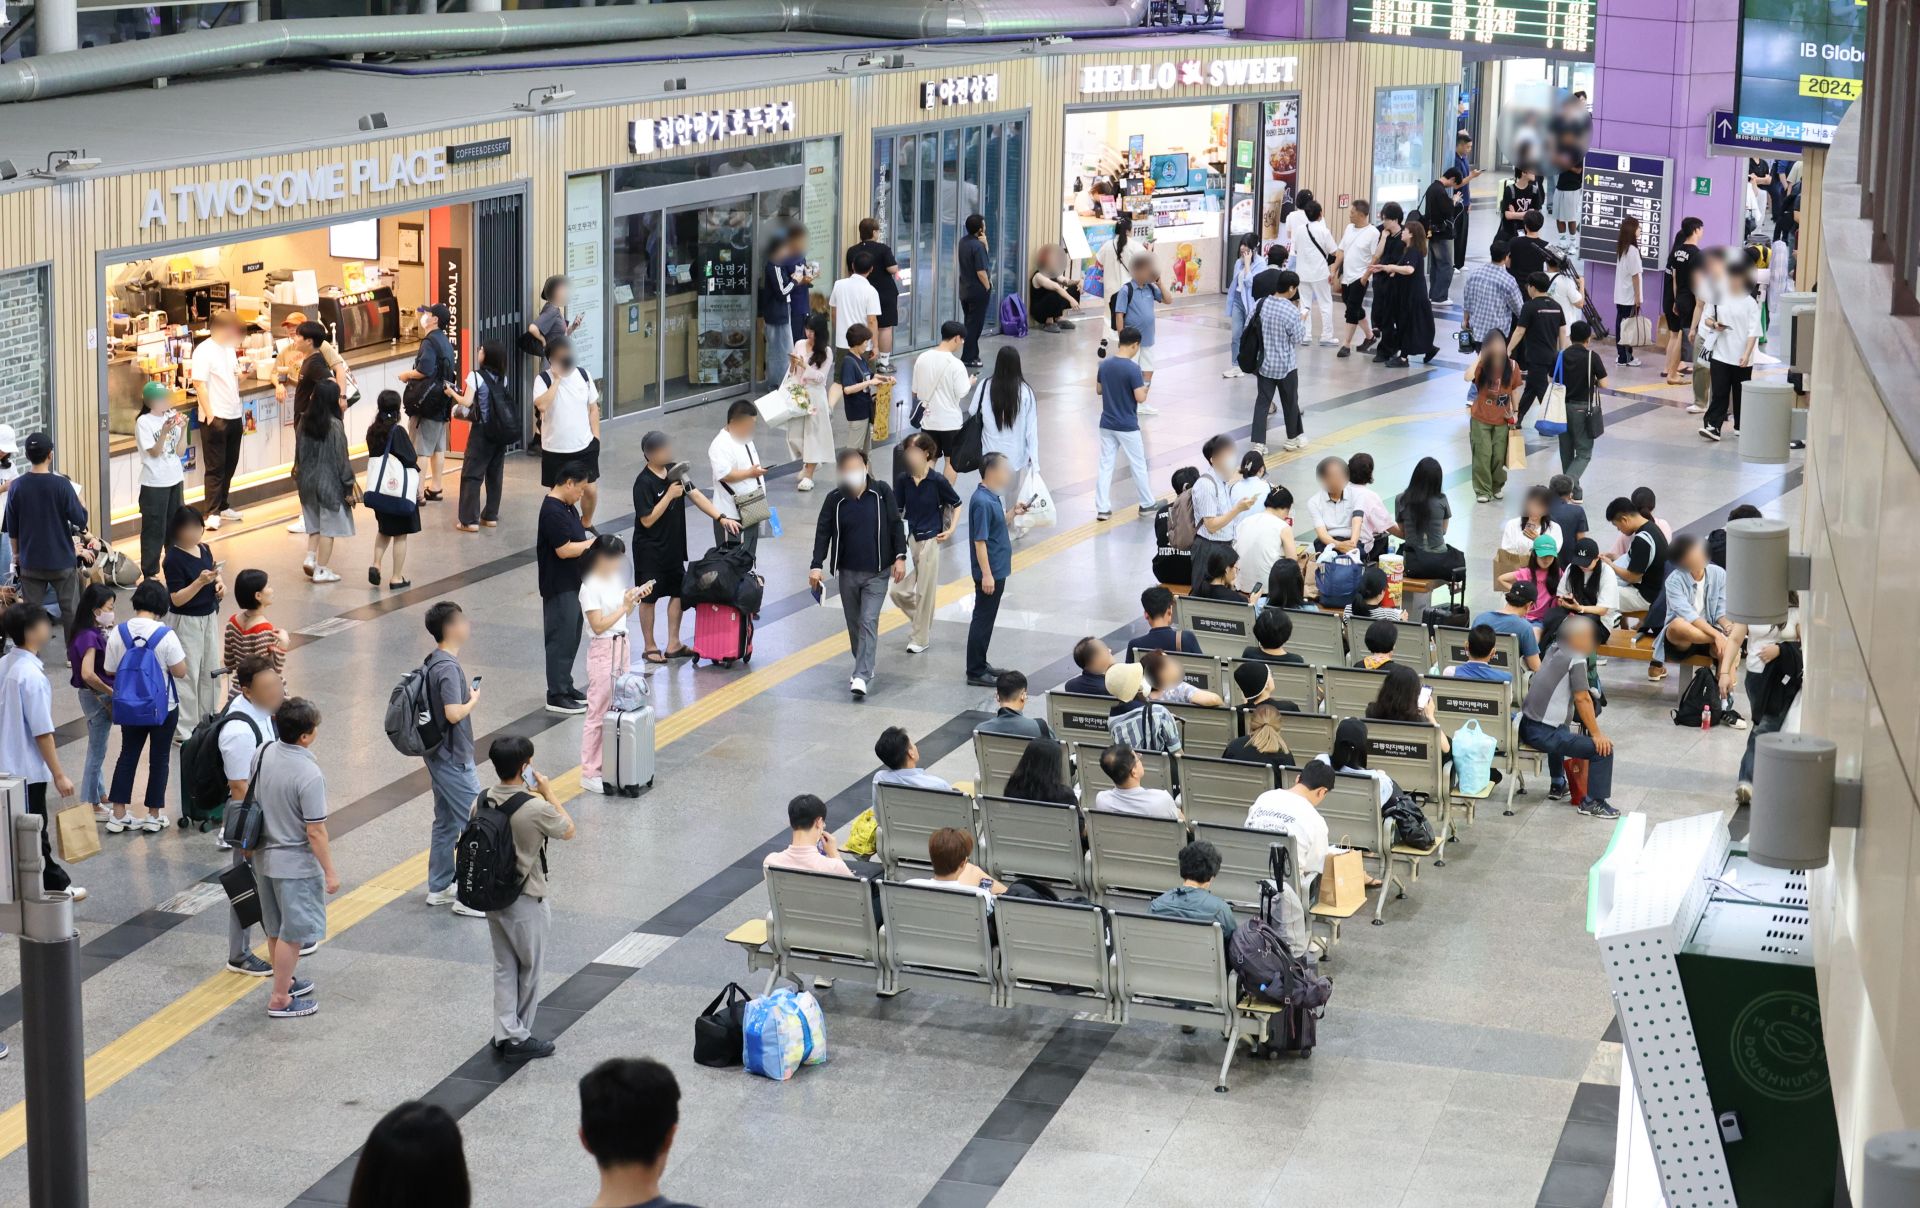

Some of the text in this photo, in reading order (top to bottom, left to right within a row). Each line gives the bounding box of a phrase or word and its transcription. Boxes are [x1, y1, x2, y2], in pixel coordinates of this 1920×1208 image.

[1800, 43, 1817, 57] IB
[1080, 57, 1297, 93] HELLO SWEET
[1809, 78, 1855, 97] 2024.
[659, 101, 796, 150] 천안명가 호두과자
[455, 141, 510, 159] COFFEE&DESSERT
[139, 150, 446, 228] A TWOSOME PLACE
[1133, 226, 1149, 236] FFEE
[448, 261, 457, 271] A
[713, 263, 748, 276] 안명가
[448, 272, 459, 346] TWOSOME
[1158, 547, 1192, 556] EVERYTHIN
[1446, 699, 1489, 709] 교통약자배려석
[1372, 742, 1418, 752] 교통약자배려석
[1744, 1036, 1819, 1088] DOUGHNUTS
